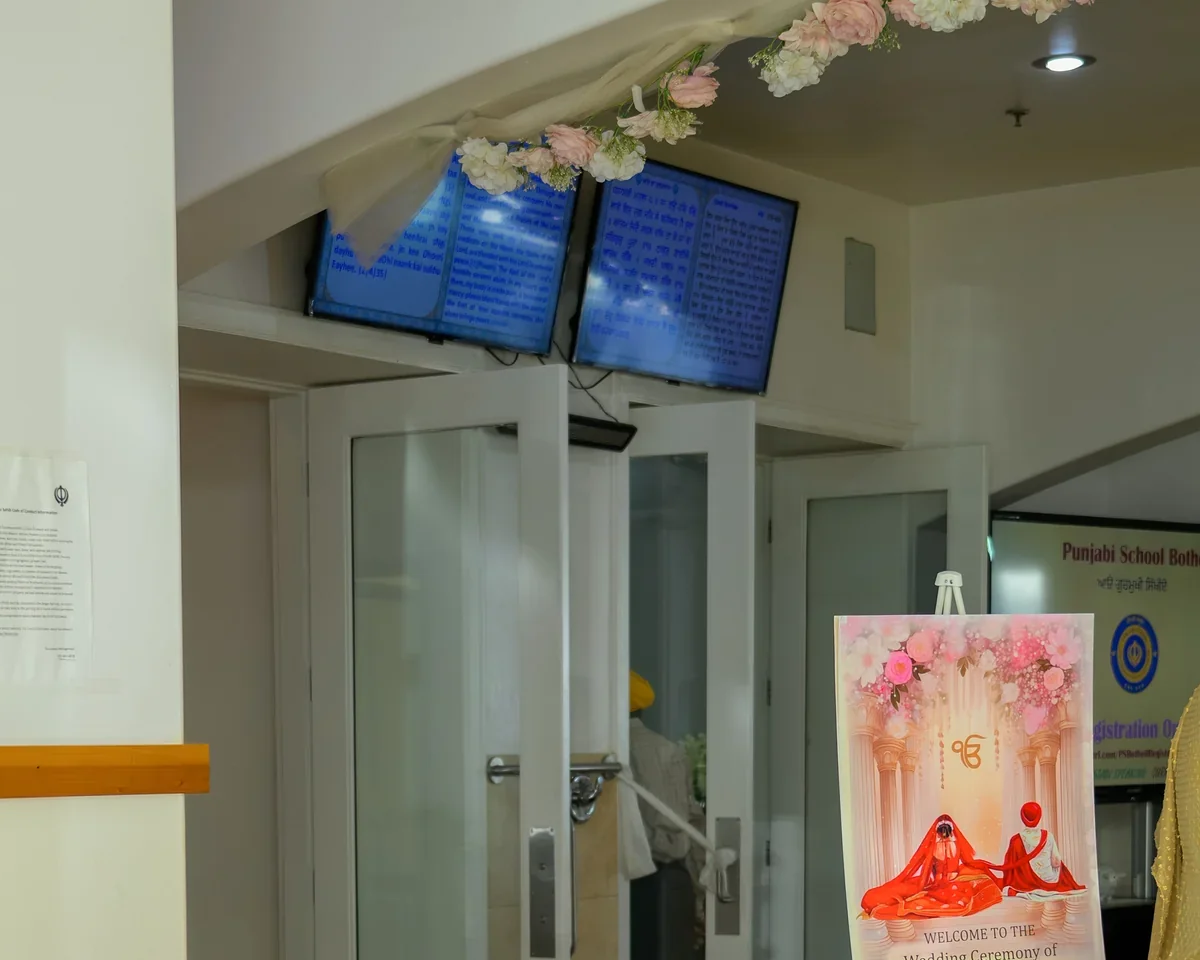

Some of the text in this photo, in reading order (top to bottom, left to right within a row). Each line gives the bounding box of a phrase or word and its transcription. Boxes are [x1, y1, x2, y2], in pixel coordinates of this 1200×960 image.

[1063, 542, 1200, 567] Punjabi School Both
[924, 924, 1036, 944] WELCOME TO THE
[1044, 943, 1058, 957] of
